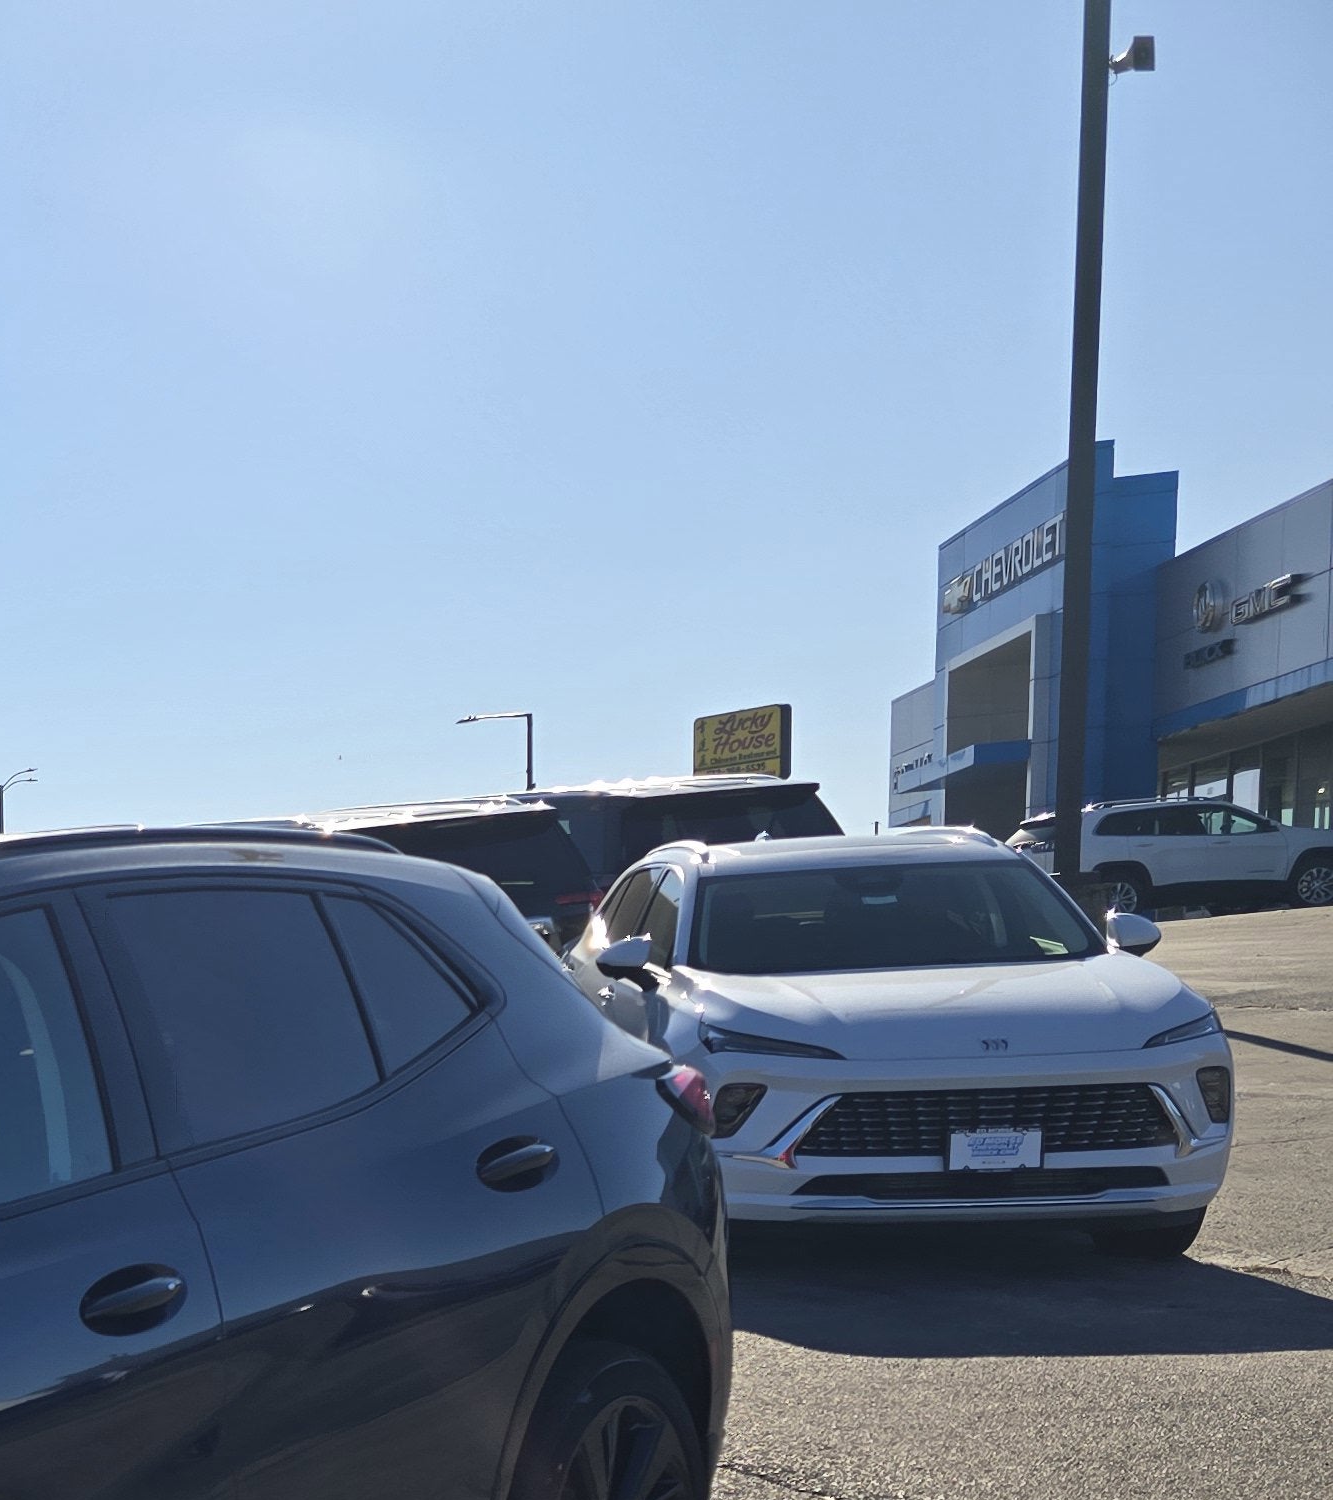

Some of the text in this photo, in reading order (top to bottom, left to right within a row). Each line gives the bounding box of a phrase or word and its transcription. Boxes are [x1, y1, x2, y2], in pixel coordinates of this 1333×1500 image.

[973, 512, 1063, 603] CHEVROLET
[1230, 573, 1292, 626] GMC
[714, 712, 773, 735] Lucky
